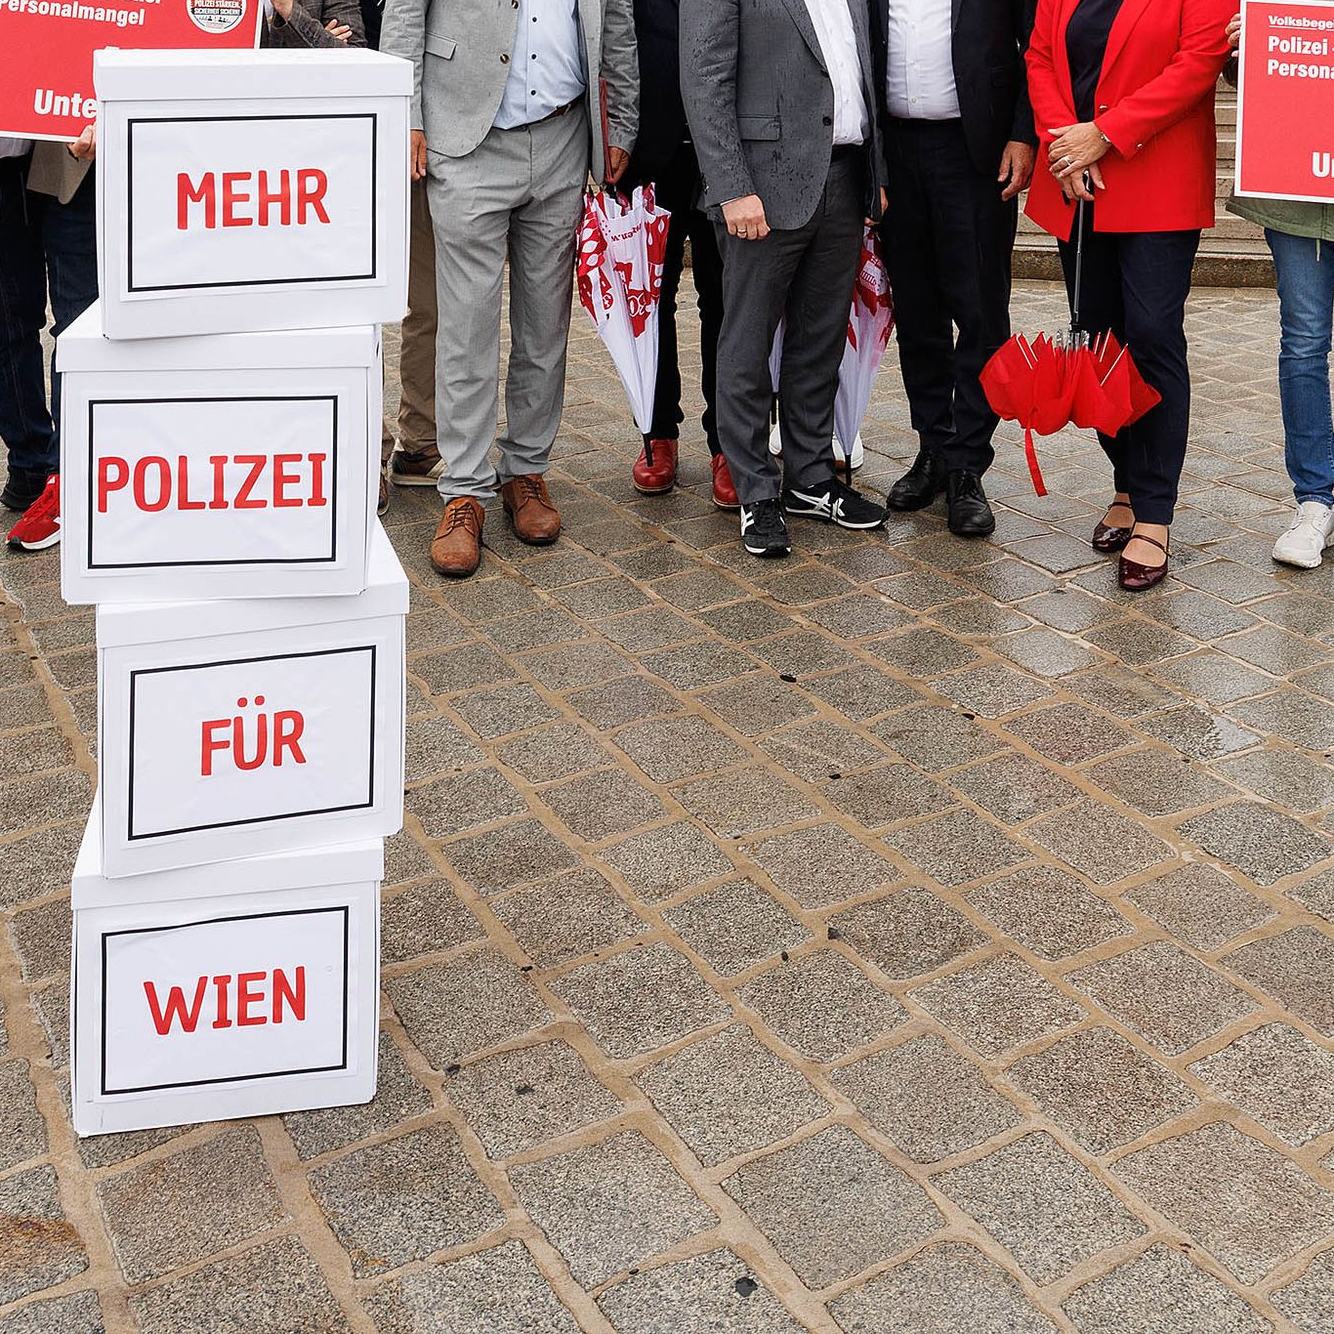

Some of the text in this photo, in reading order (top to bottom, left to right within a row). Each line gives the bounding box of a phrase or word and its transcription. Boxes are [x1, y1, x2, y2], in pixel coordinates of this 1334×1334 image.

[1268, 35, 1328, 56] Polizei
[176, 167, 331, 231] MEHR
[97, 452, 328, 514] POLIZEI
[200, 695, 306, 777] FÜR
[143, 965, 306, 1036] WIEN
